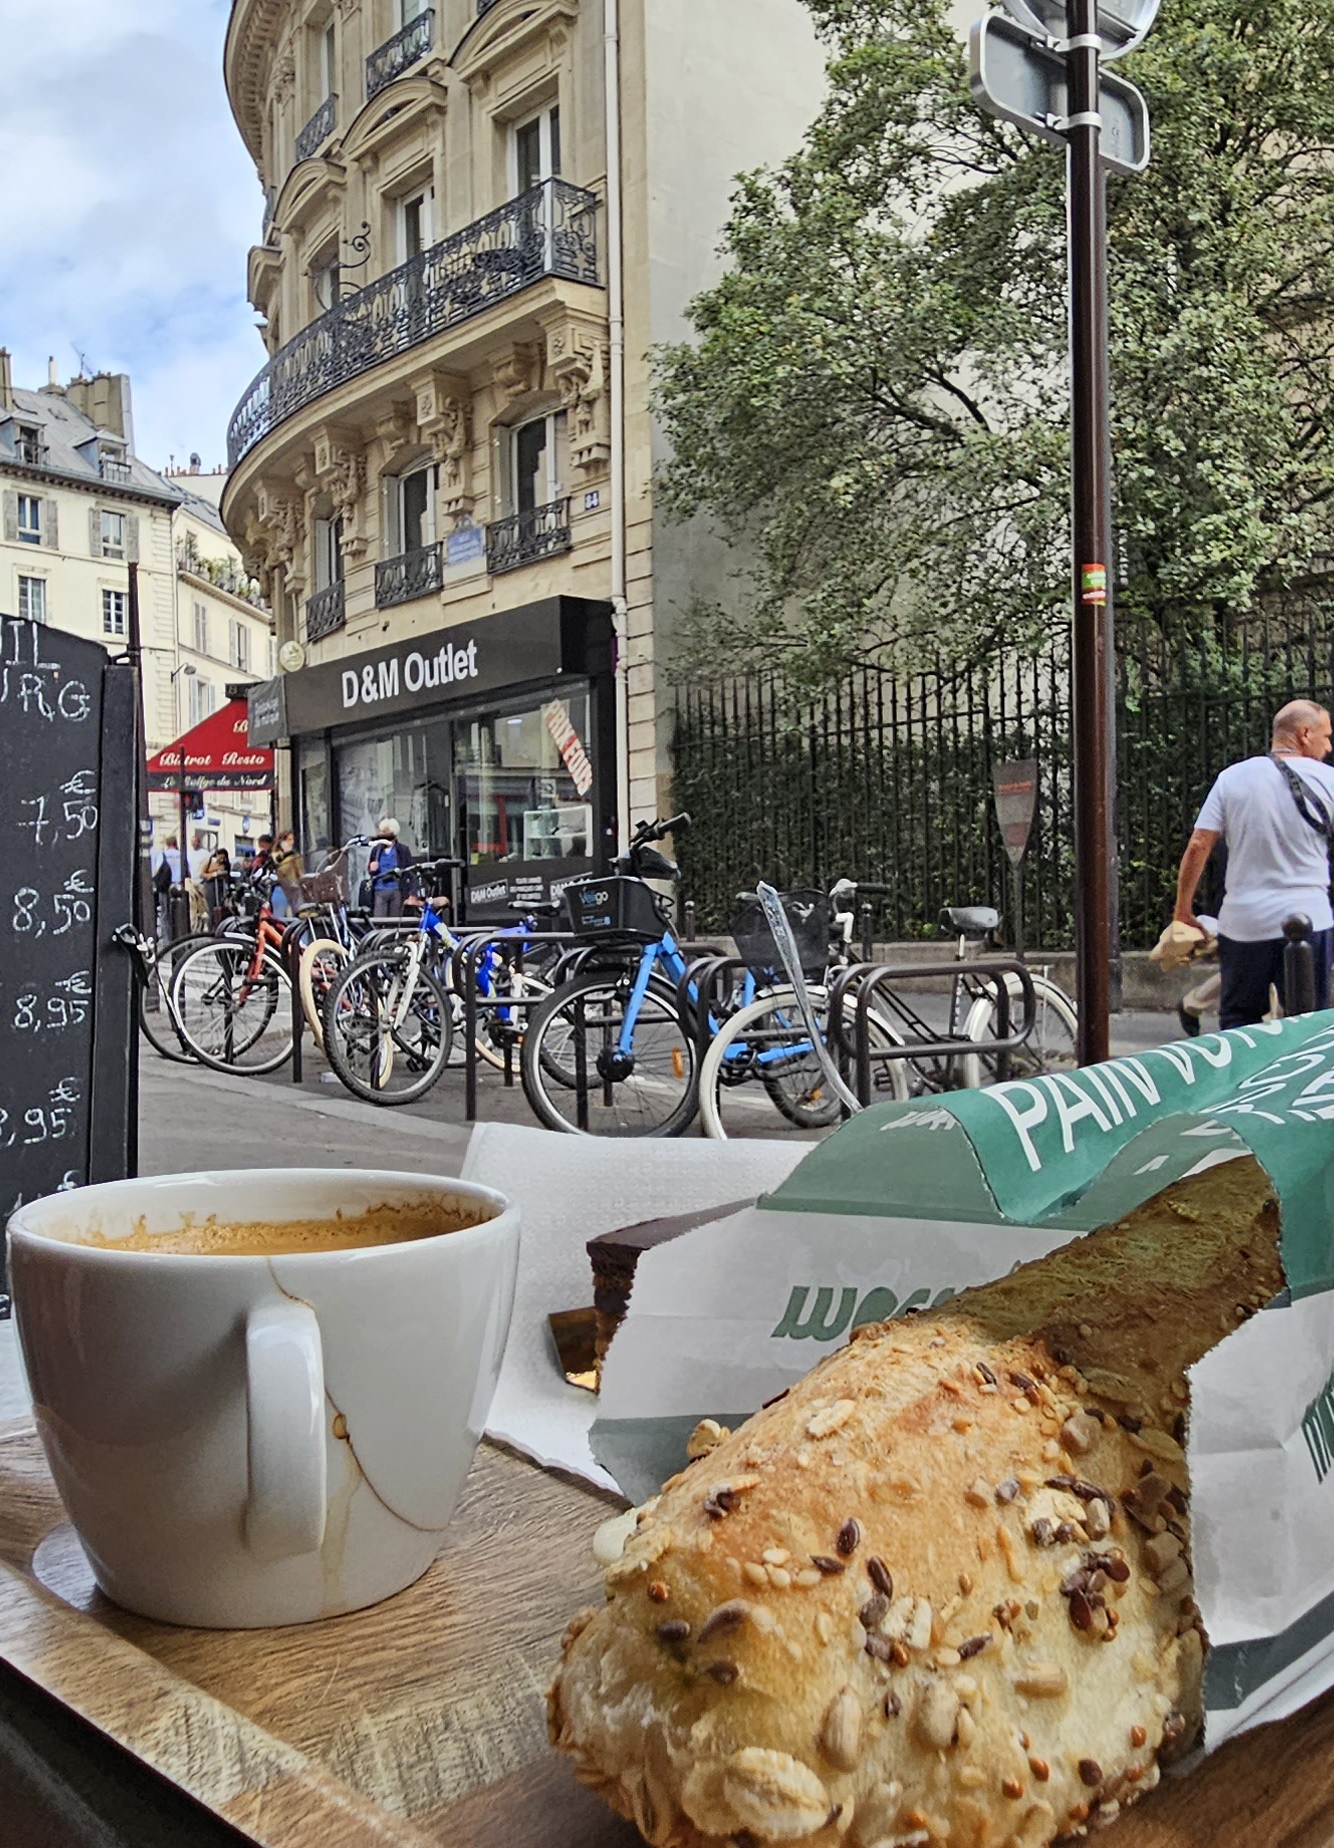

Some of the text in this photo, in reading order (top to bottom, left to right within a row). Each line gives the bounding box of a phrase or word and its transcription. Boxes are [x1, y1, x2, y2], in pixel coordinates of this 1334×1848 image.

[342, 638, 478, 708] D&M Outlet
[159, 751, 265, 767] Bitrot Resto
[58, 769, 97, 795] €
[234, 774, 267, 786] Nord
[17, 795, 98, 846] 7,50
[63, 869, 95, 894] €
[12, 885, 93, 939] 8,50
[54, 970, 92, 995] €
[14, 991, 92, 1033] 8,95
[48, 1076, 81, 1103] €
[980, 1055, 1162, 1173] PAIN
